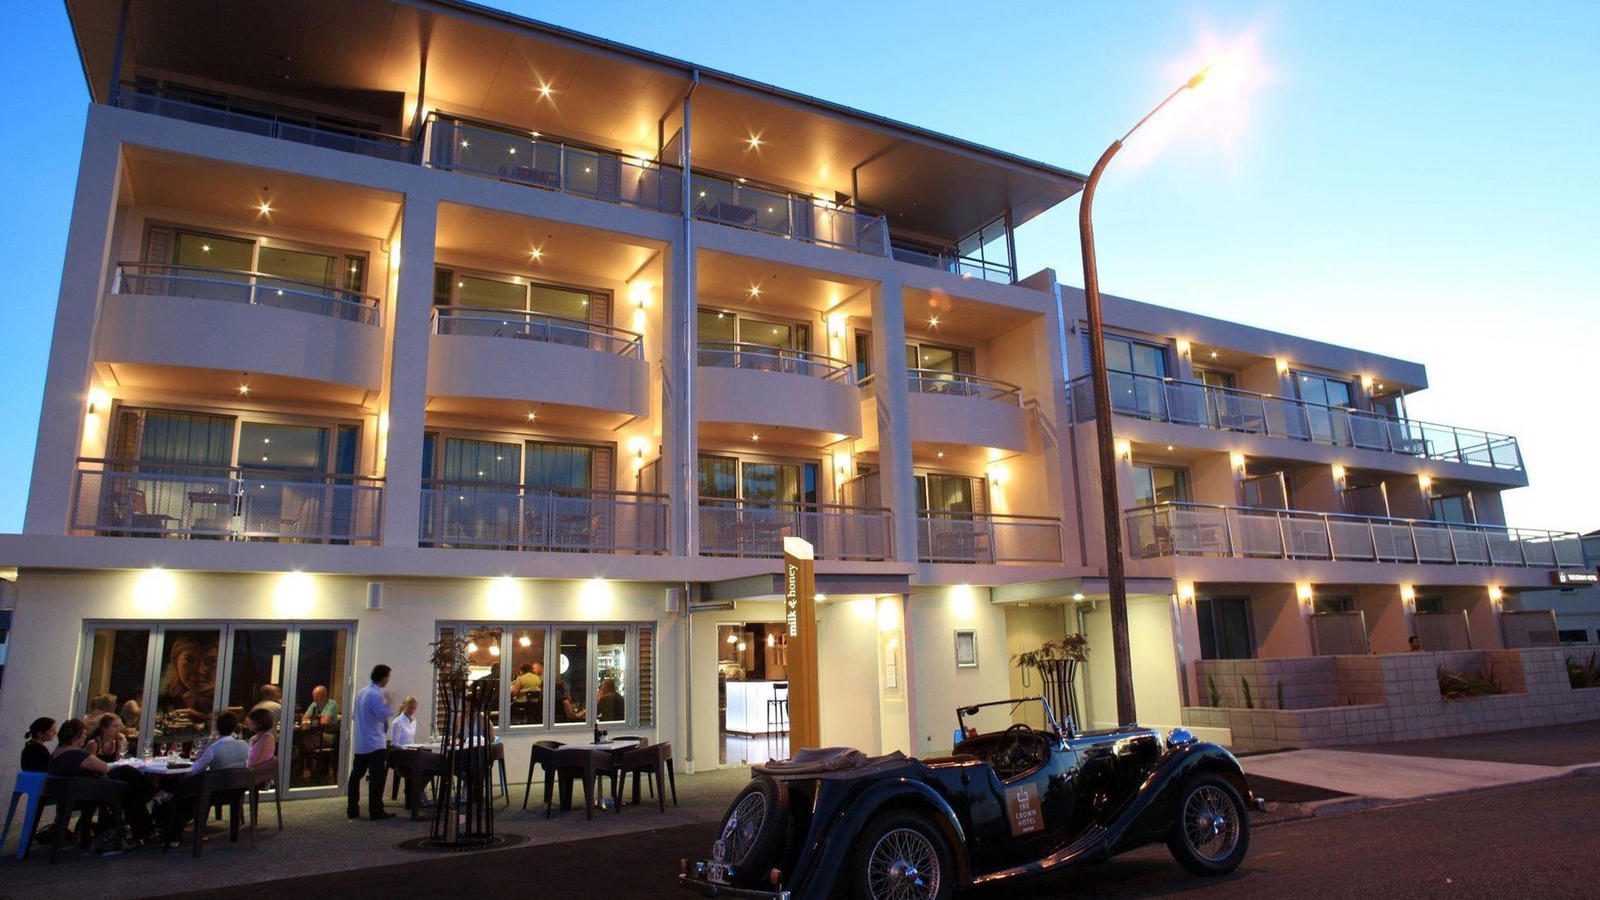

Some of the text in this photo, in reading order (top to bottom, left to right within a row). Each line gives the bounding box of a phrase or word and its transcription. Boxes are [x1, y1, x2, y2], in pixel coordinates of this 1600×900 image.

[787, 564, 798, 637] milk & honey
[1015, 809, 1037, 819] CROWN
[1018, 818, 1036, 827] HOTEL
